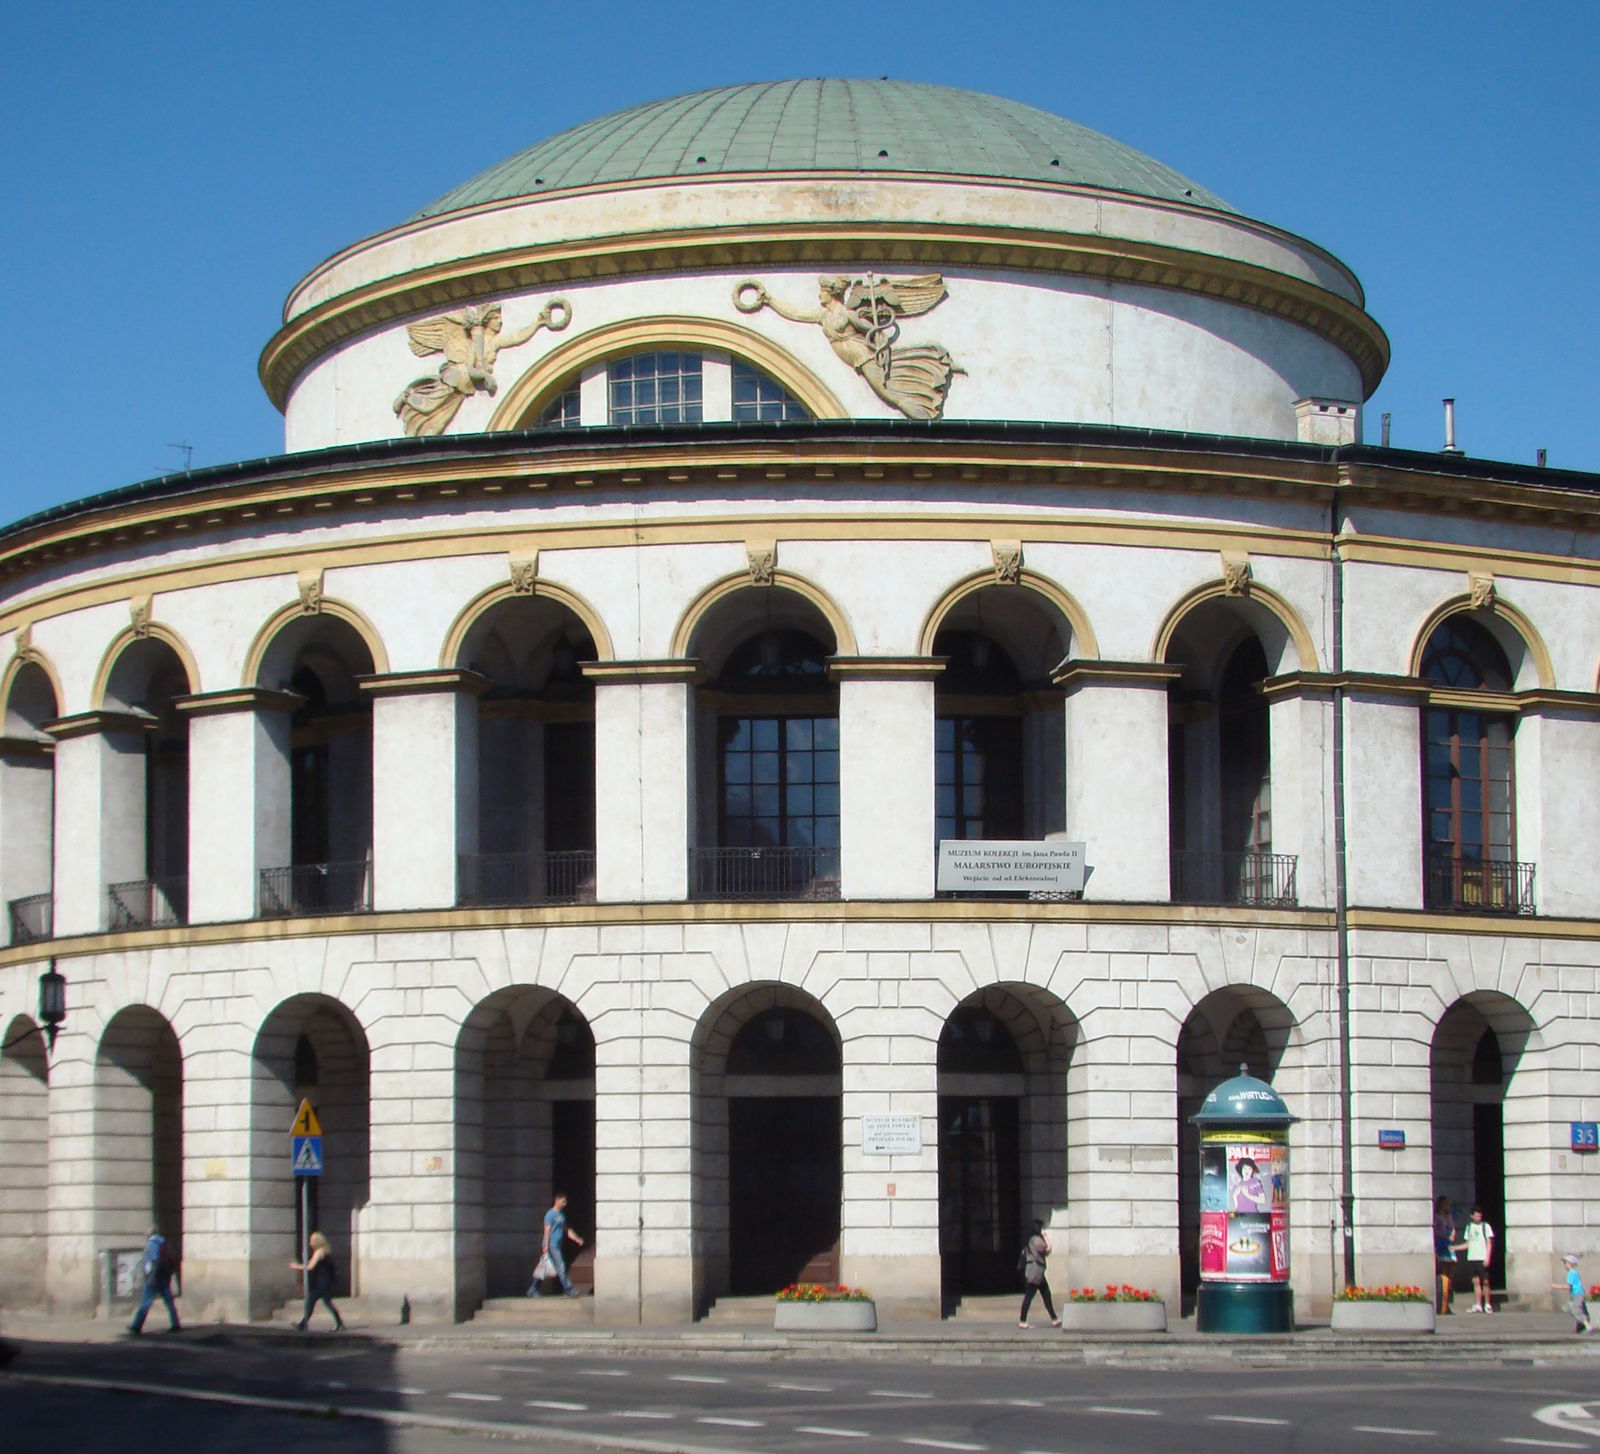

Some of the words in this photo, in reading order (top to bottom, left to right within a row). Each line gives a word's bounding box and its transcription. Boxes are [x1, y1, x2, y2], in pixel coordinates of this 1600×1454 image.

[983, 850, 1018, 858] KOLEKCJI
[1033, 850, 1048, 858] Jana
[1014, 862, 1071, 870] EUROPEJSKIE
